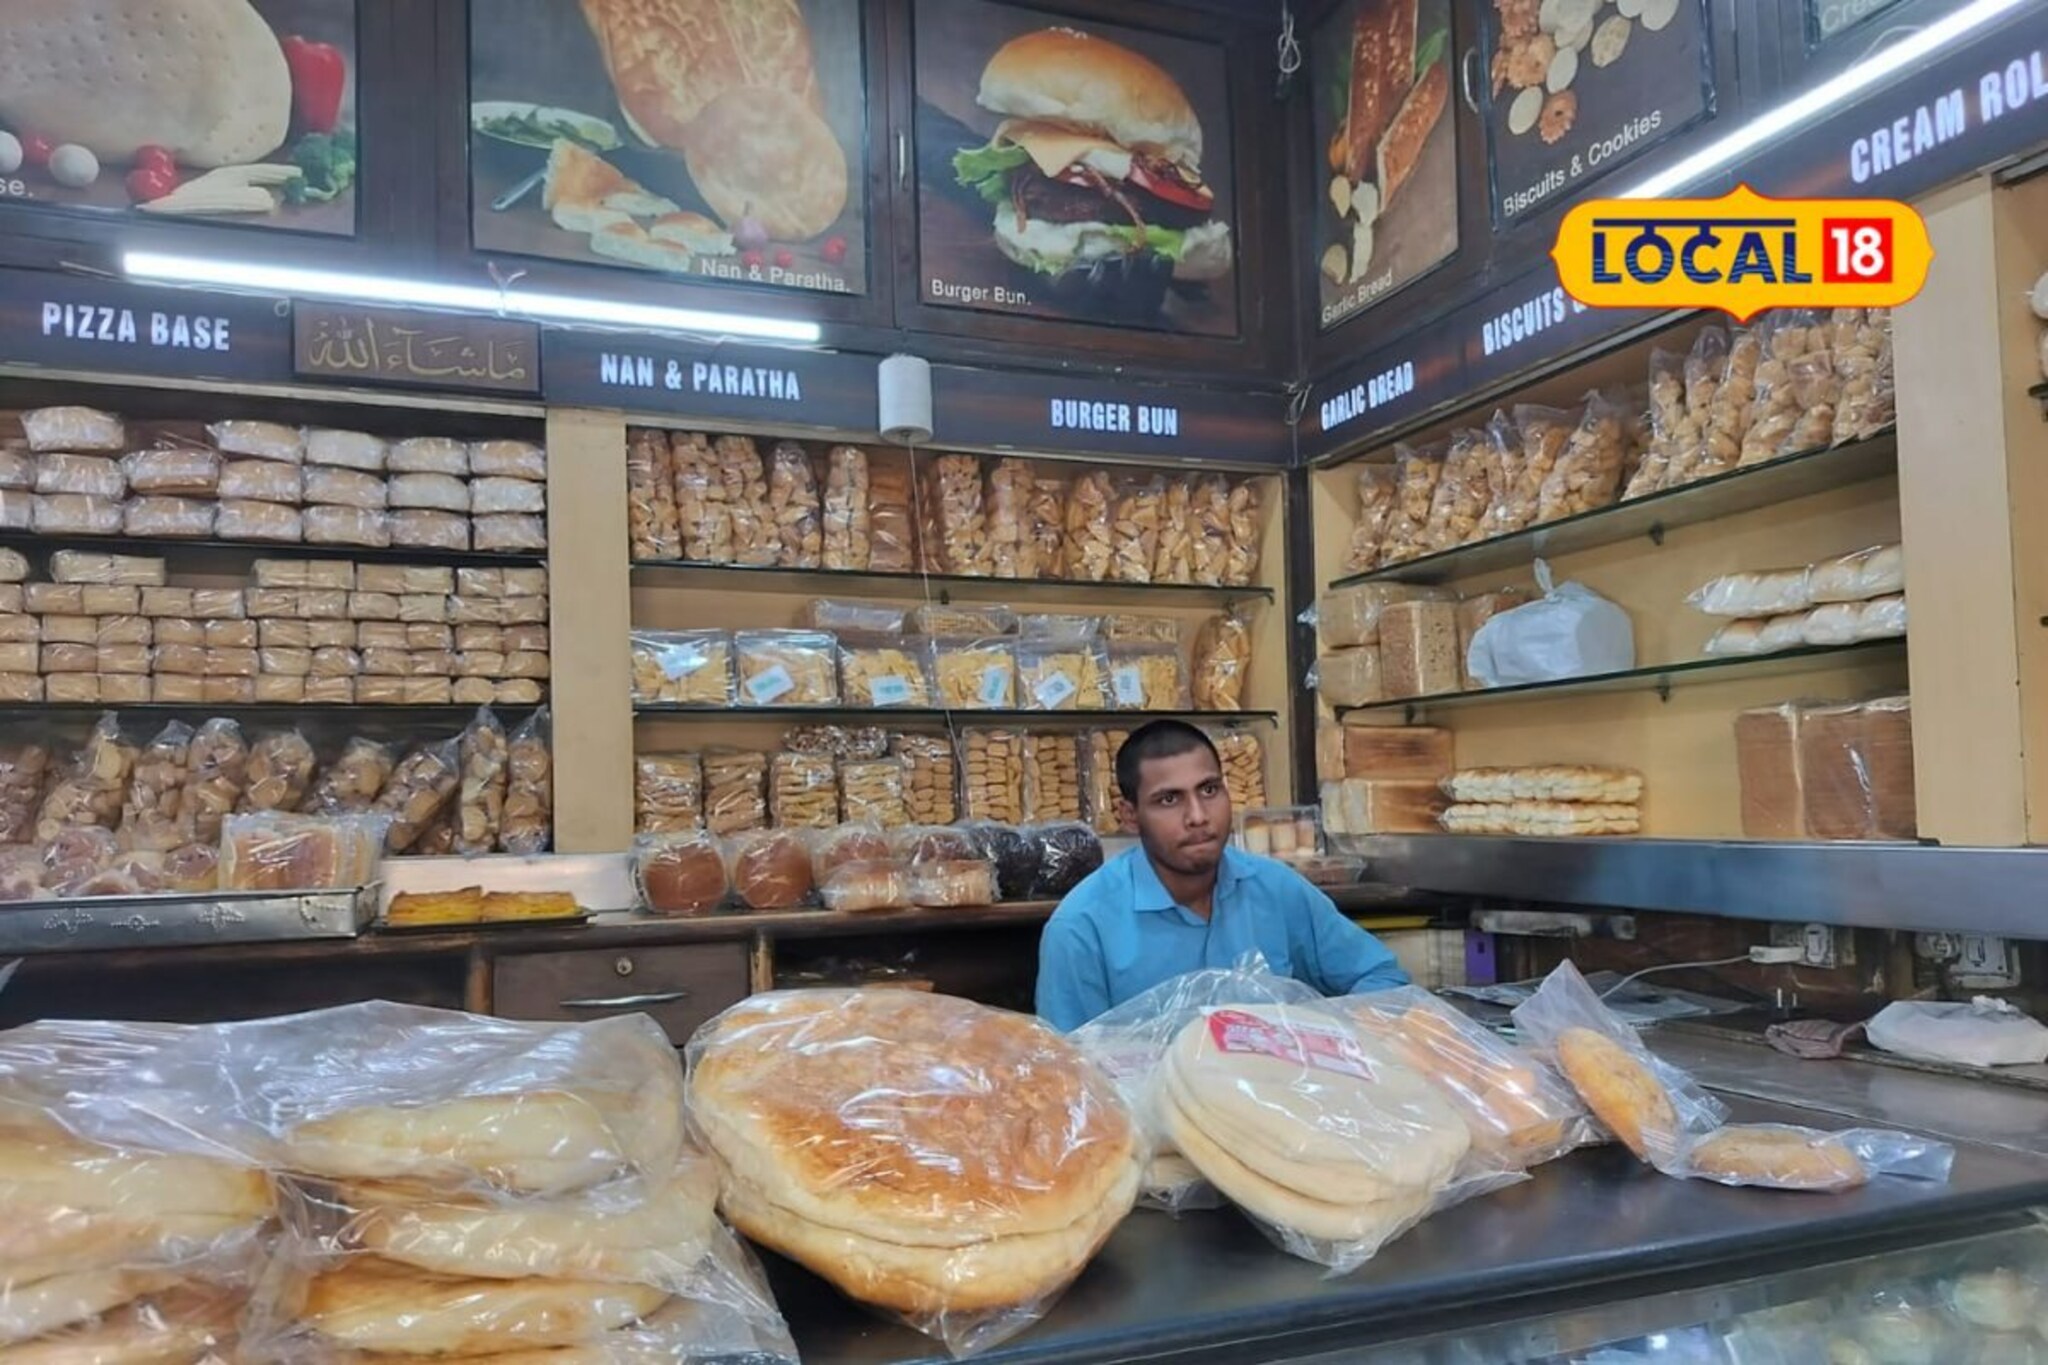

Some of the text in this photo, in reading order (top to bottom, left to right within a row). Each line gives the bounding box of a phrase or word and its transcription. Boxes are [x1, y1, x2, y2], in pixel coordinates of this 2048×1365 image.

[1851, 50, 2048, 183] CREAM ROL
[1503, 110, 1662, 216] Biscuits & Cookies
[702, 258, 852, 292] Nan & Paratha.
[932, 279, 1032, 305] Burger Bun.
[1322, 267, 1392, 323] Garlic Bread
[42, 302, 230, 350] PIZZA BASE
[1482, 286, 1566, 356] BISCUITS
[601, 353, 800, 400] NAN & PARATHA
[1321, 360, 1414, 431] GARLIC BREAD
[1051, 398, 1177, 435] BURGER BUN
